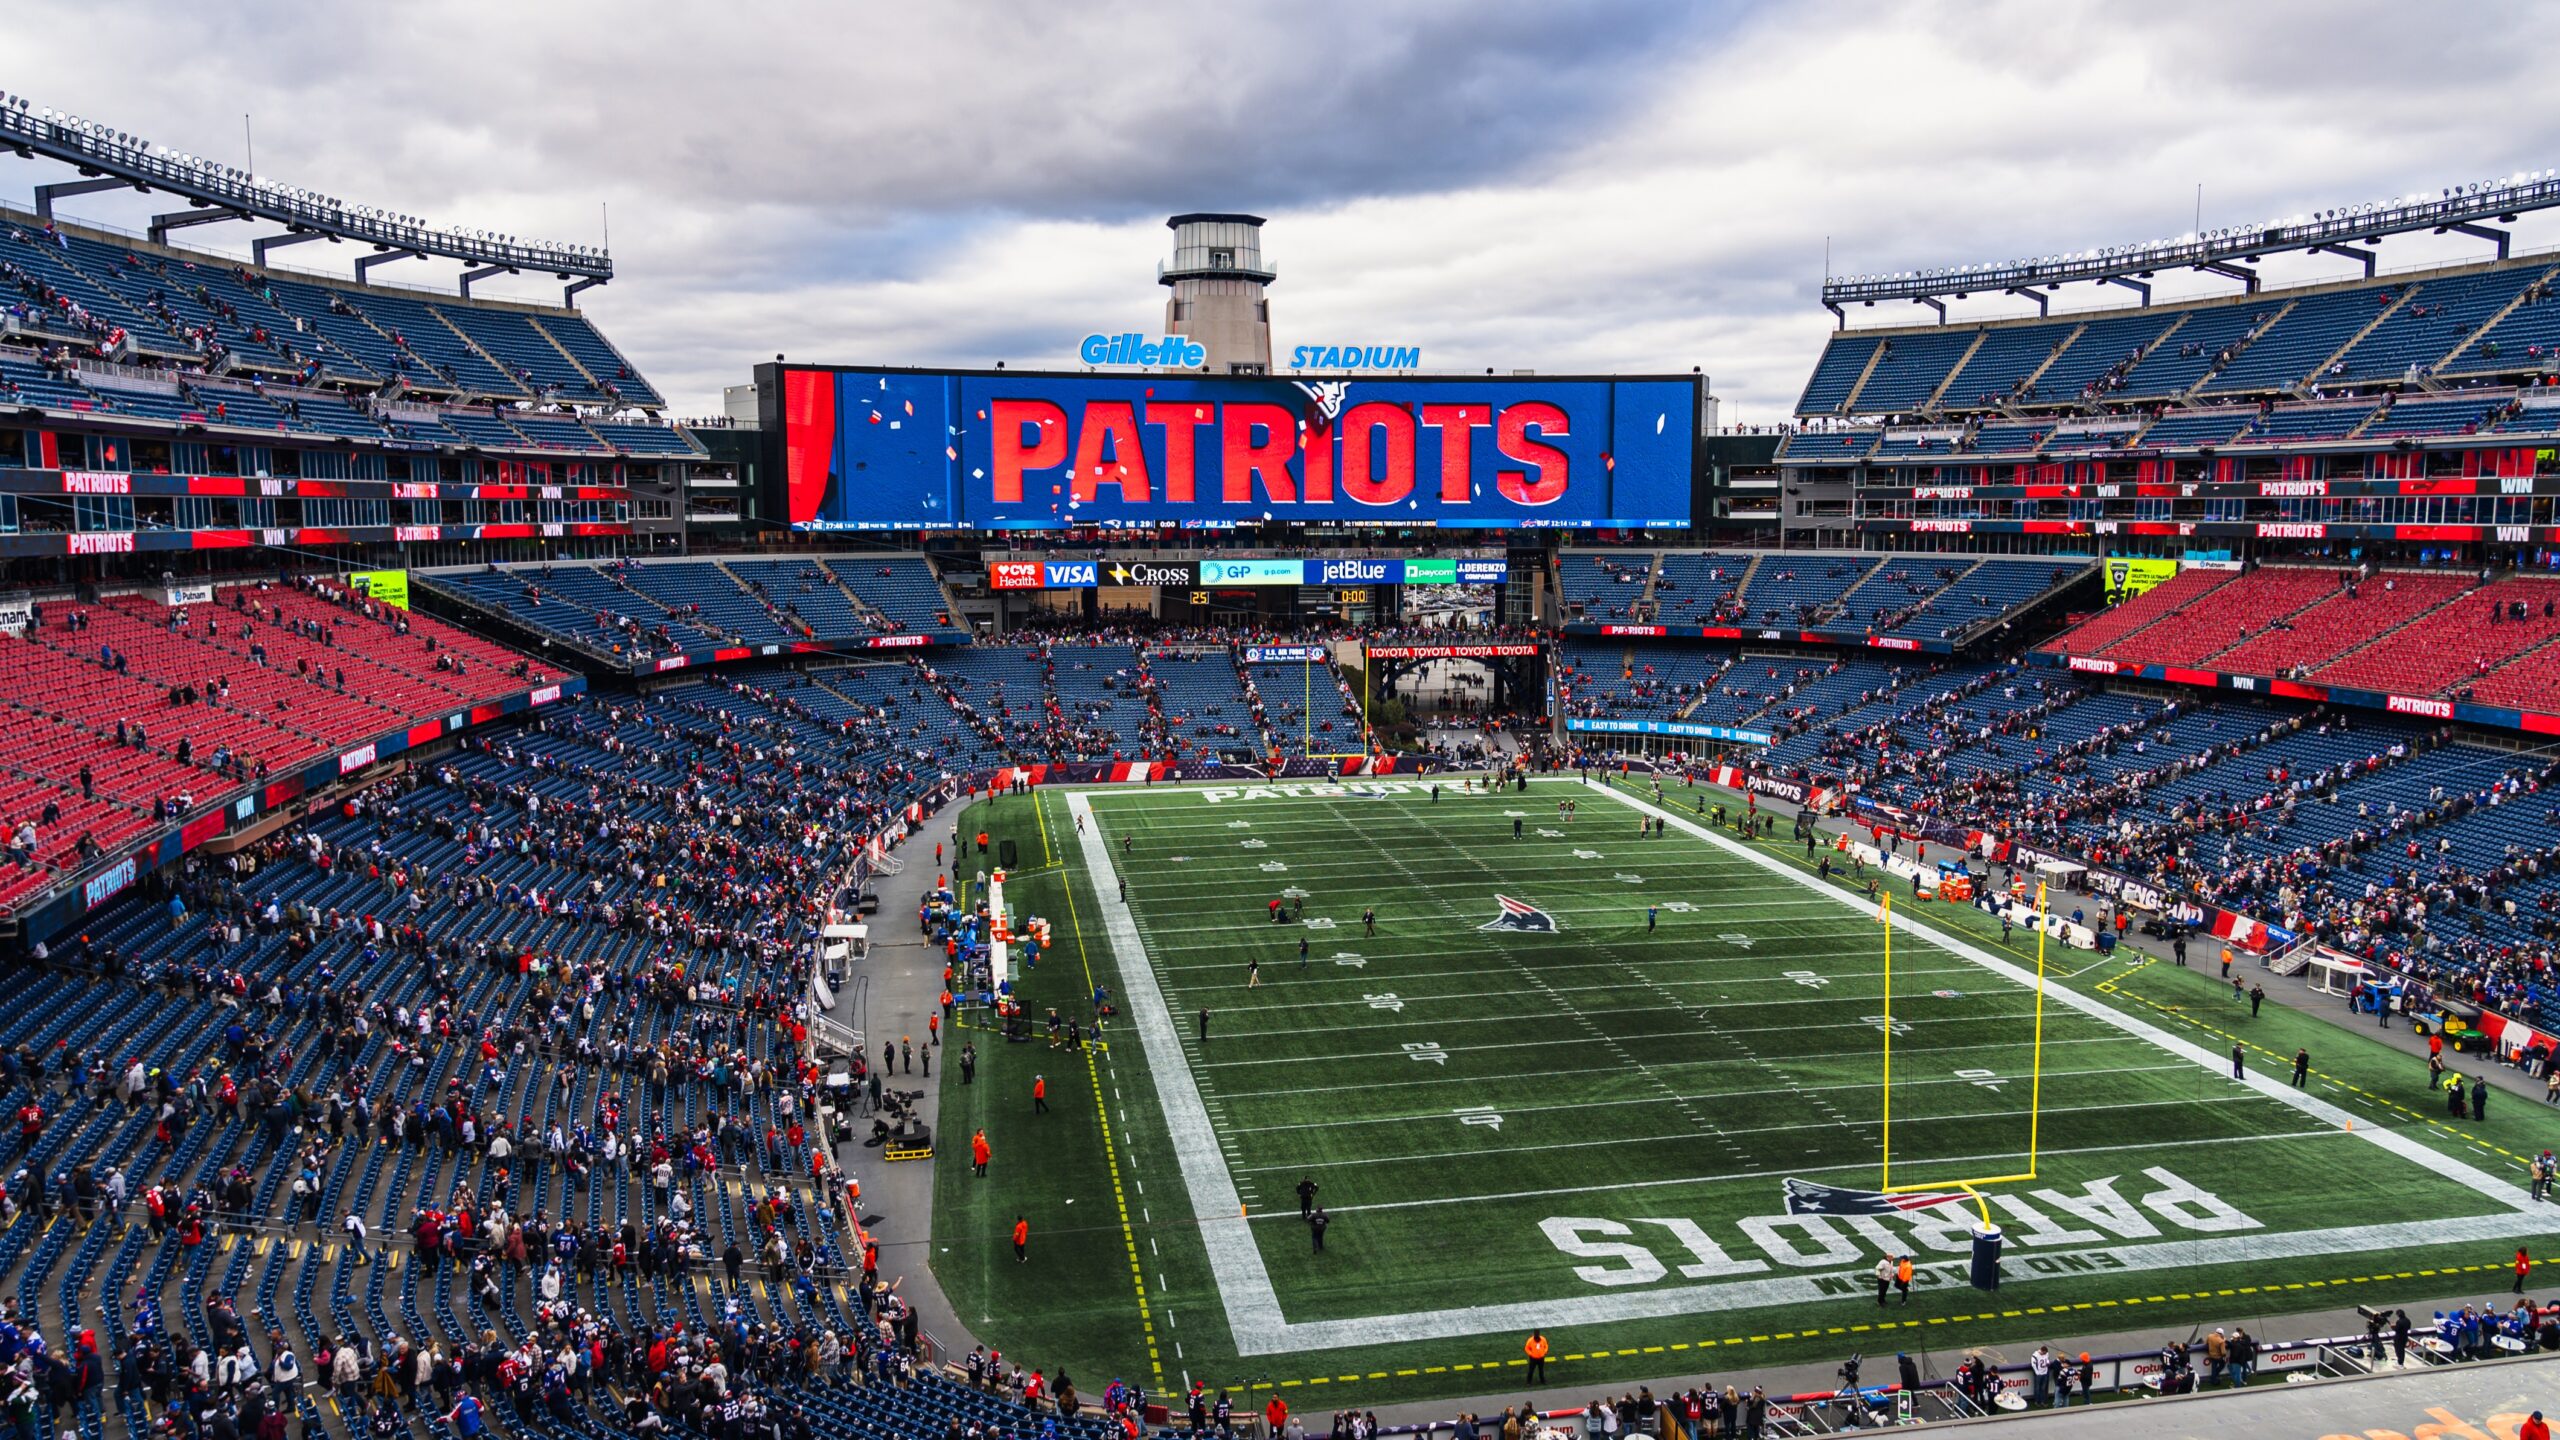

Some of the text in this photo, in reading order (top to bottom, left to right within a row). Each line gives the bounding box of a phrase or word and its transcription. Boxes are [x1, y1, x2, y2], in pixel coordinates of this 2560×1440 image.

[1080, 333, 1205, 367] Gillette
[1290, 345, 1420, 369] STADIUM
[991, 398, 1570, 506] PATRIOTS
[65, 473, 129, 493] PATRIOTS
[261, 479, 282, 495] WIN
[2261, 481, 2326, 496] PATRIOTS
[2500, 478, 2533, 494] WIN
[542, 486, 562, 498] WIN
[1914, 487, 1970, 499] PATRIOTS
[2097, 484, 2120, 497] WIN
[543, 524, 563, 537] WIN
[812, 522, 823, 530] NE
[1159, 521, 1176, 529] 0:00
[1205, 520, 1218, 528] BUF
[1913, 520, 1968, 532] PATRIOTS
[2095, 522, 2117, 534] WIN
[263, 529, 285, 546] WIN
[2258, 524, 2323, 538] PATRIOTS
[2496, 526, 2530, 541] WIN
[70, 533, 133, 553] PATRIOTS
[1010, 564, 1036, 576] CVS
[1321, 560, 1387, 583] jetBlue
[1457, 563, 1506, 572] J.DERENZO
[2205, 561, 2226, 569] Putnam
[1046, 565, 1096, 584] VISA
[1418, 567, 1454, 578] paycom
[182, 590, 207, 602] Putnam
[1191, 591, 1207, 604] 25
[1341, 590, 1366, 603] 0:00
[1611, 625, 1656, 635] PATRIOTS
[1762, 629, 1781, 640] WIN
[878, 635, 923, 647] PATRIOTS
[1878, 637, 1913, 651] PATRIOTS
[762, 644, 779, 655] WIN
[1289, 648, 1307, 656] FORCE
[1370, 645, 1535, 658] TOYOTA TOYOTA TOYOTA TOYOTA
[2069, 657, 2115, 673] PATRIOTS
[2232, 676, 2255, 690] WIN
[531, 685, 561, 705] PATRIOTS
[2388, 696, 2451, 718] PATRIOTS
[1591, 721, 1639, 731] EASY TO DRINK
[1668, 724, 1713, 736] EASY TO DRINK
[1735, 730, 1749, 741] EASY
[341, 744, 376, 773] PATRIOTS
[1201, 782, 1491, 803] PATRIOTS
[1747, 775, 1802, 801] PATRIOTS
[236, 794, 256, 821] WIN
[86, 856, 136, 908] PATRIOTS
[2122, 881, 2205, 924] ENGAND
[1401, 1041, 1449, 1062] 20
[28, 1112, 39, 1122] 12
[1452, 1105, 1504, 1126] 10
[1537, 1165, 2266, 1287] PATRIOTS
[2025, 1251, 2127, 1274] END
[2451, 1328, 2458, 1337] 8
[2271, 1352, 2306, 1364] Optum
[506, 1367, 514, 1378] 11
[1989, 1383, 1999, 1394] 11
[1189, 1399, 1195, 1409] 9
[1705, 1399, 1718, 1410] 54
[724, 1404, 740, 1420] 22
[1218, 1408, 1229, 1418] 27
[376, 1420, 393, 1432] 37
